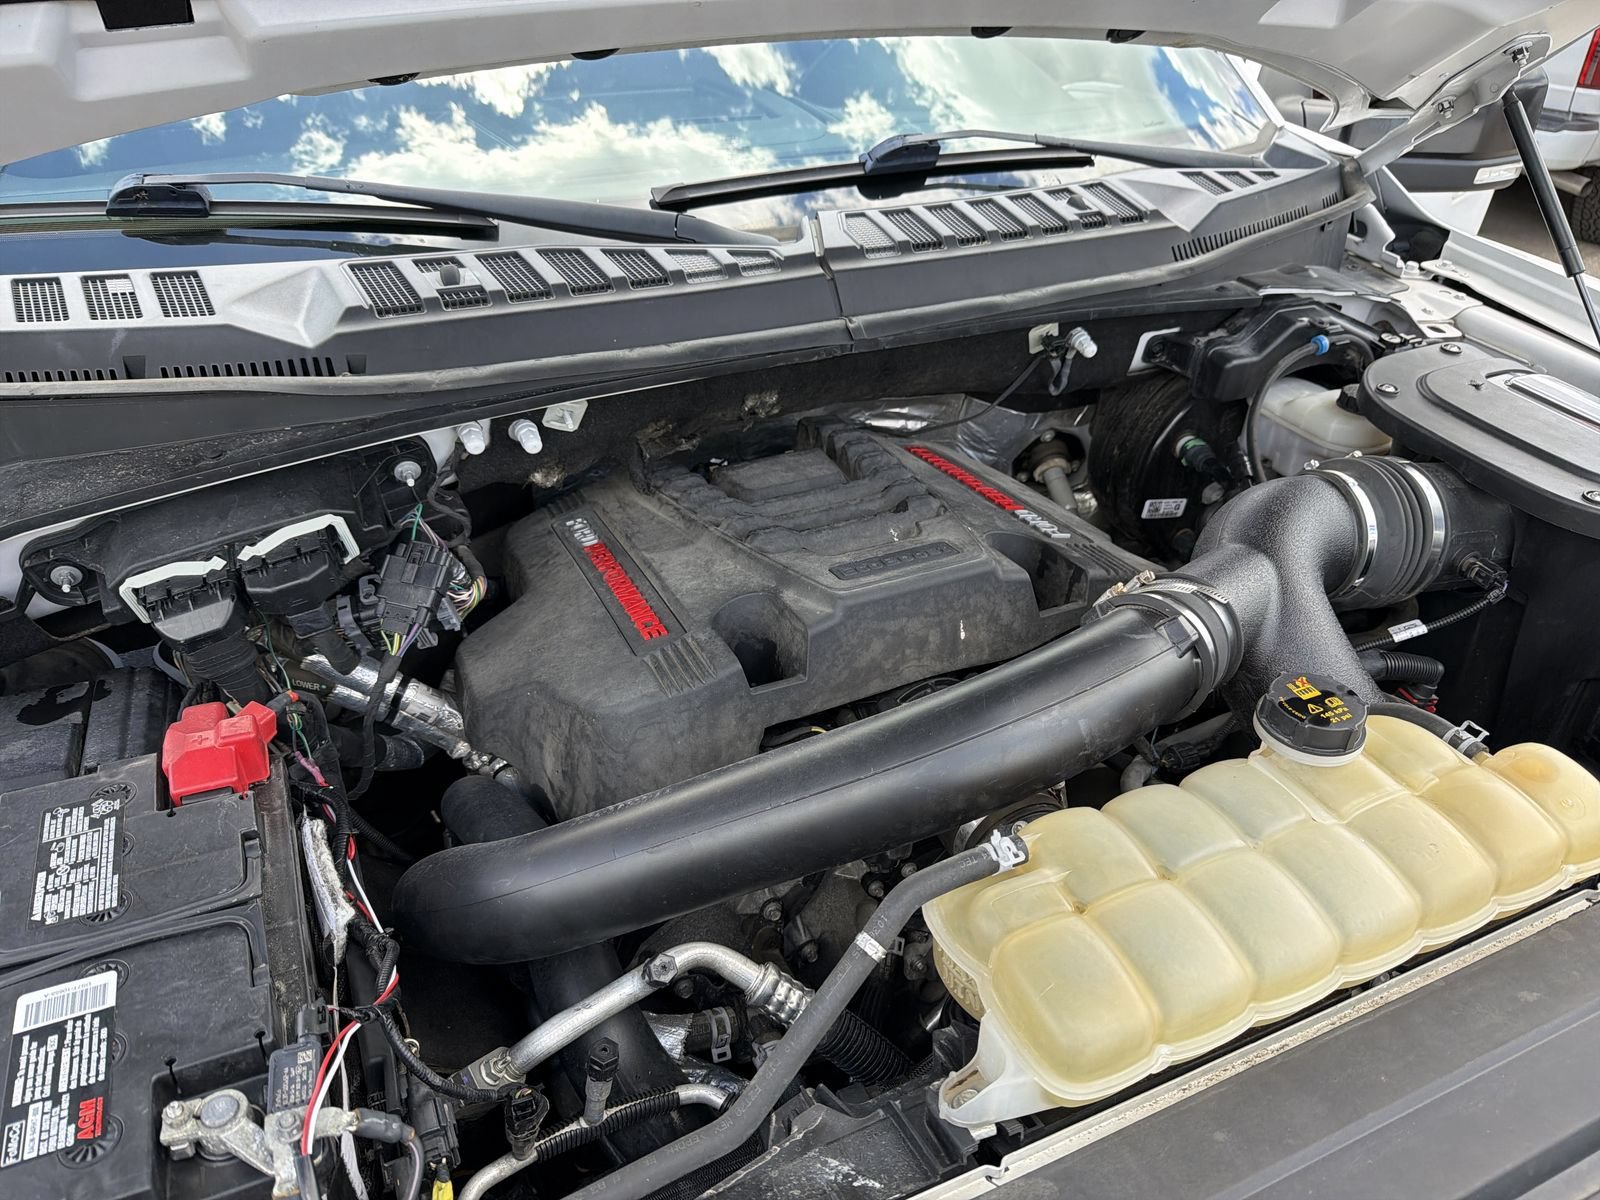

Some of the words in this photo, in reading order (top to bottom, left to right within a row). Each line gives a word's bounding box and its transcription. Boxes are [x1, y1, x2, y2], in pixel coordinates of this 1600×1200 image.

[565, 518, 599, 547] FORD
[583, 540, 669, 641] PERFORMANCE
[292, 679, 320, 691] LOWER
[1320, 710, 1335, 719] 145
[1333, 707, 1349, 715] kPa
[1330, 716, 1341, 724] 21
[1340, 712, 1353, 721] psi
[77, 1097, 97, 1140] AGM
